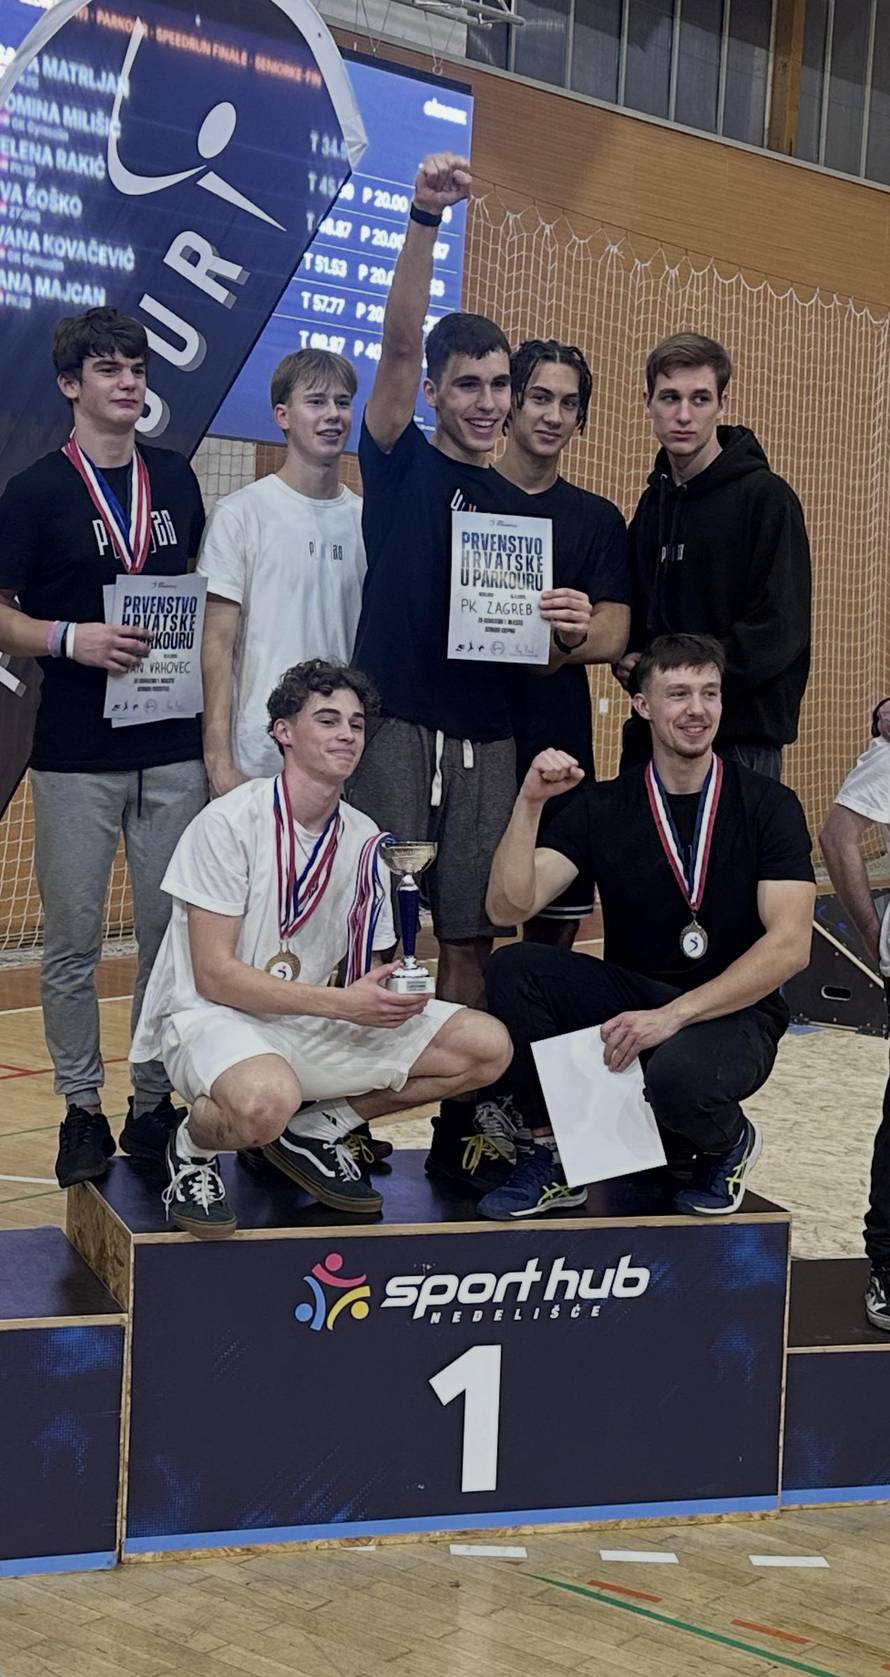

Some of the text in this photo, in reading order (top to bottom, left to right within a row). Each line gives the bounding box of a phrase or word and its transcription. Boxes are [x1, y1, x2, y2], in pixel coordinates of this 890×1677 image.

[97, 8, 148, 38] PARKOR
[155, 27, 211, 57] SPEEDRUN
[212, 41, 248, 67] FINALE
[42, 54, 129, 98] MATRLJAN
[310, 132, 319, 153] T
[56, 147, 105, 181] RAKIĆ
[25, 182, 83, 218] ŠOŠKO
[308, 172, 317, 192] T
[362, 186, 372, 204] P
[374, 190, 409, 213] 20.00
[306, 210, 315, 232] T
[360, 225, 370, 242] P
[43, 233, 135, 272] KOVAČEVIĆ
[303, 252, 313, 270] T
[315, 255, 347, 278] 51.53
[358, 263, 368, 281] P
[35, 275, 106, 307] MAJCAN
[301, 291, 311, 309] T
[313, 294, 345, 315] 57.77
[356, 302, 366, 319] P
[299, 330, 309, 349] T
[354, 340, 364, 357] P
[461, 531, 542, 555] PRVENSTVO
[461, 550, 543, 573] HRVATSKE
[461, 569, 543, 591] U PARKOURU
[123, 595, 198, 614] PRVENSTVO
[461, 598, 533, 616] PK ZAGREB
[121, 613, 196, 632] HRVATSKE
[146, 631, 194, 650] RKOURU
[150, 661, 191, 674] VRHOVEC
[430, 1304, 601, 1325] NEDELIŠĆE
[428, 1344, 502, 1493] 1
